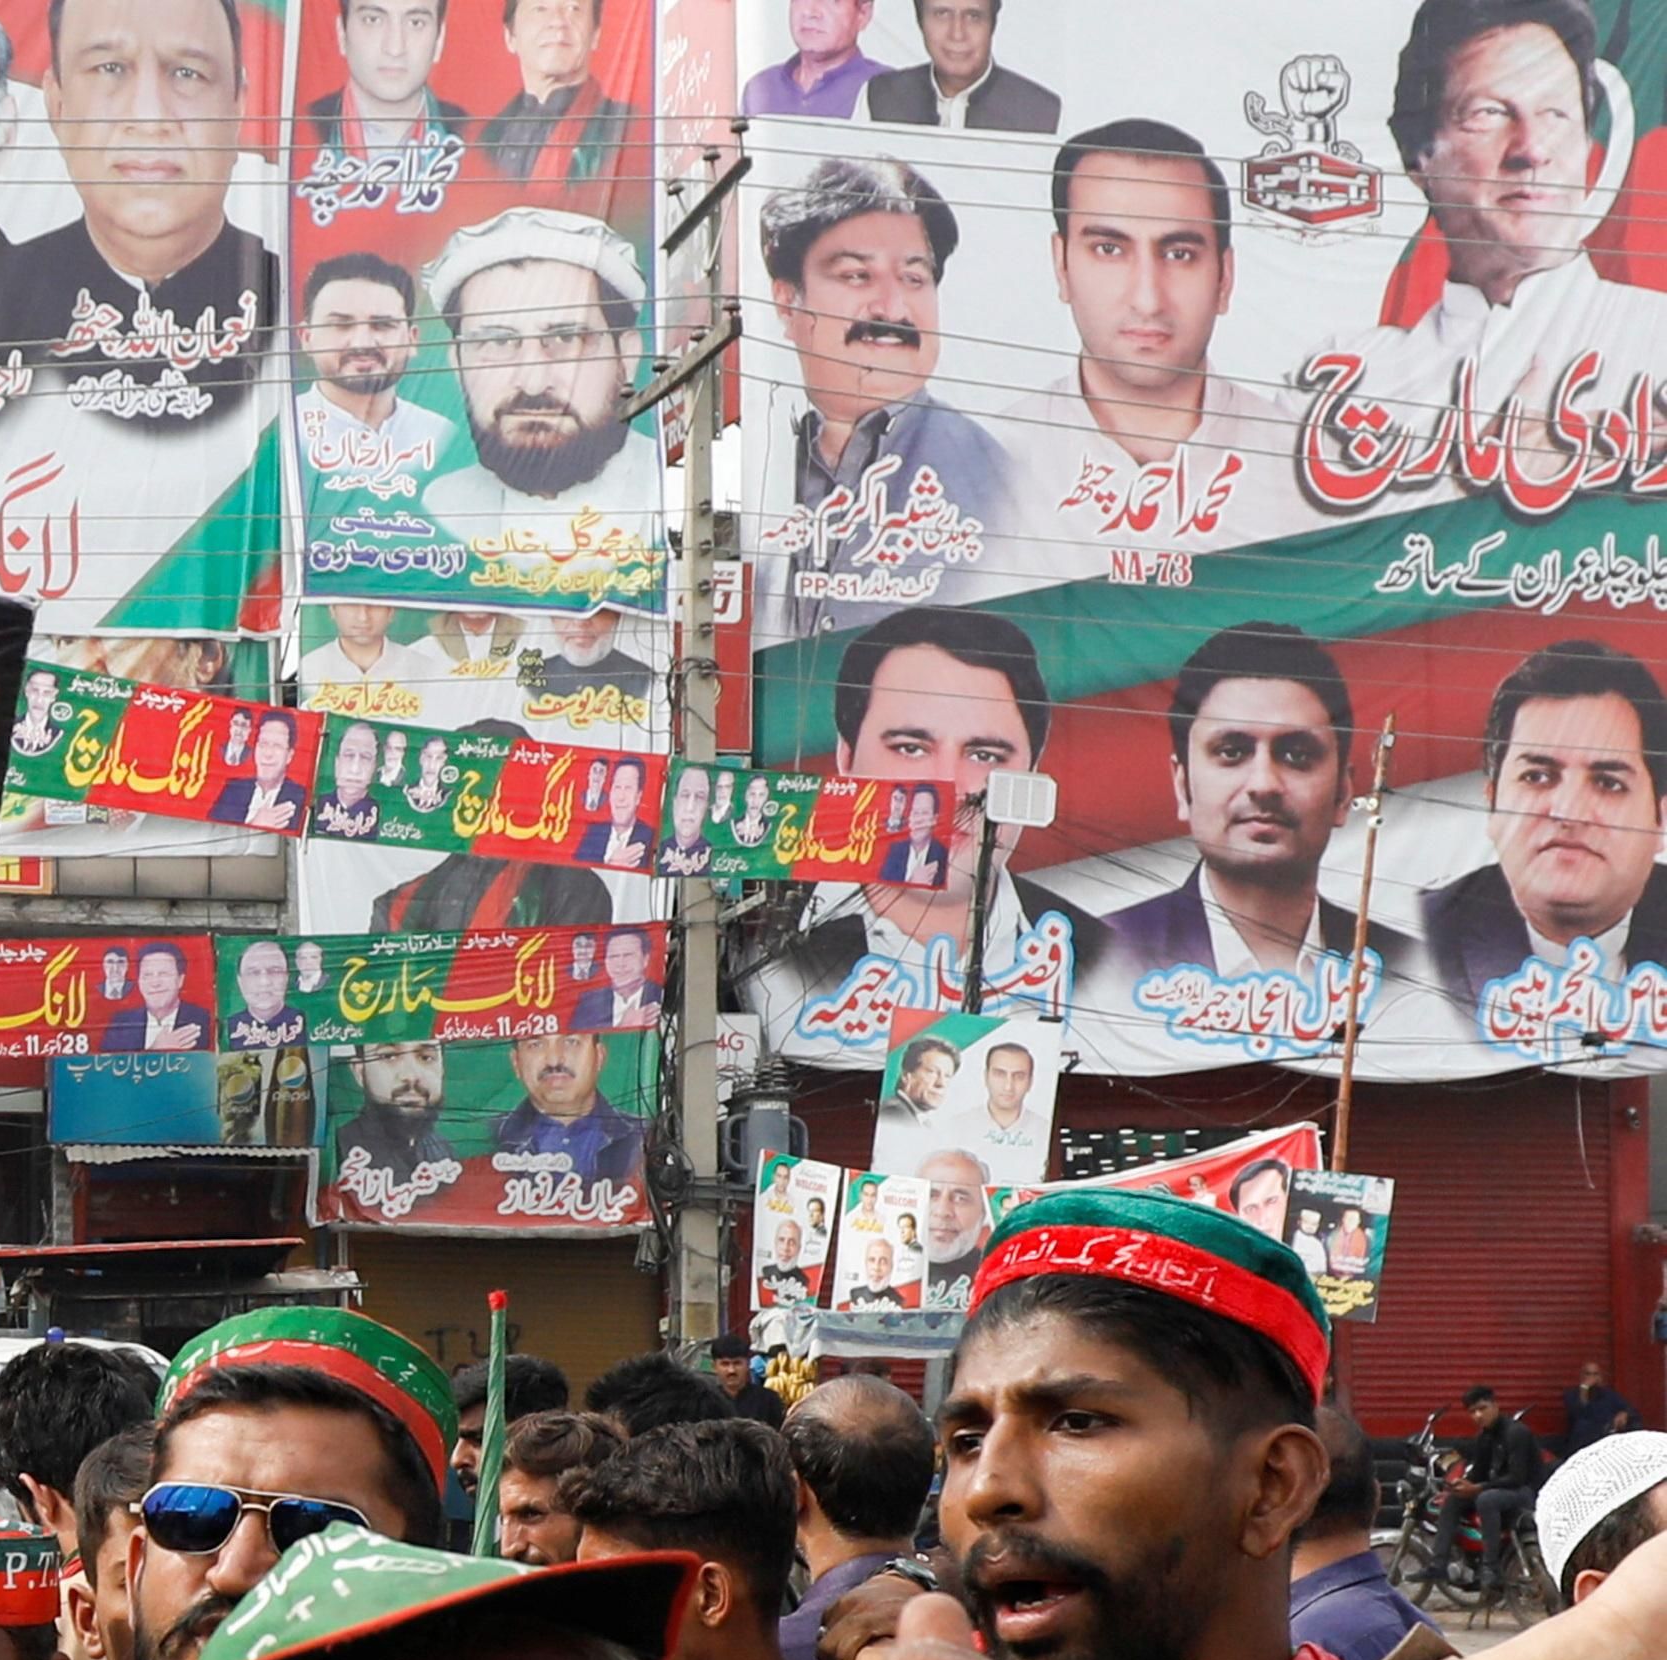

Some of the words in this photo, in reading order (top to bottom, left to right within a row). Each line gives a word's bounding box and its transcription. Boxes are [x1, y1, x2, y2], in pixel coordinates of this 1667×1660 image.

[302, 410, 329, 425] PP
[306, 425, 326, 439] 51
[1305, 352, 1503, 504] مارچ
[1099, 445, 1187, 535] احمد
[1173, 451, 1244, 539] محمد
[331, 507, 435, 539] حقیقی
[470, 529, 541, 562] خان
[1454, 530, 1513, 595] کے
[1108, 551, 1193, 586] NA-73
[1377, 533, 1466, 595] ساتھ
[798, 576, 859, 598] PP-51
[1511, 548, 1598, 616] عمران
[428, 931, 557, 1014] لانگ
[807, 962, 895, 1033] چیمہ
[495, 1015, 512, 1038] 11
[531, 1013, 560, 1036] 28
[1223, 981, 1291, 1051] اعجاز
[23, 1033, 41, 1057] 11
[61, 1033, 89, 1057] 28
[714, 1031, 745, 1053] 4G
[271, 1088, 311, 1103] pepsi
[575, 1178, 636, 1219] میاں
